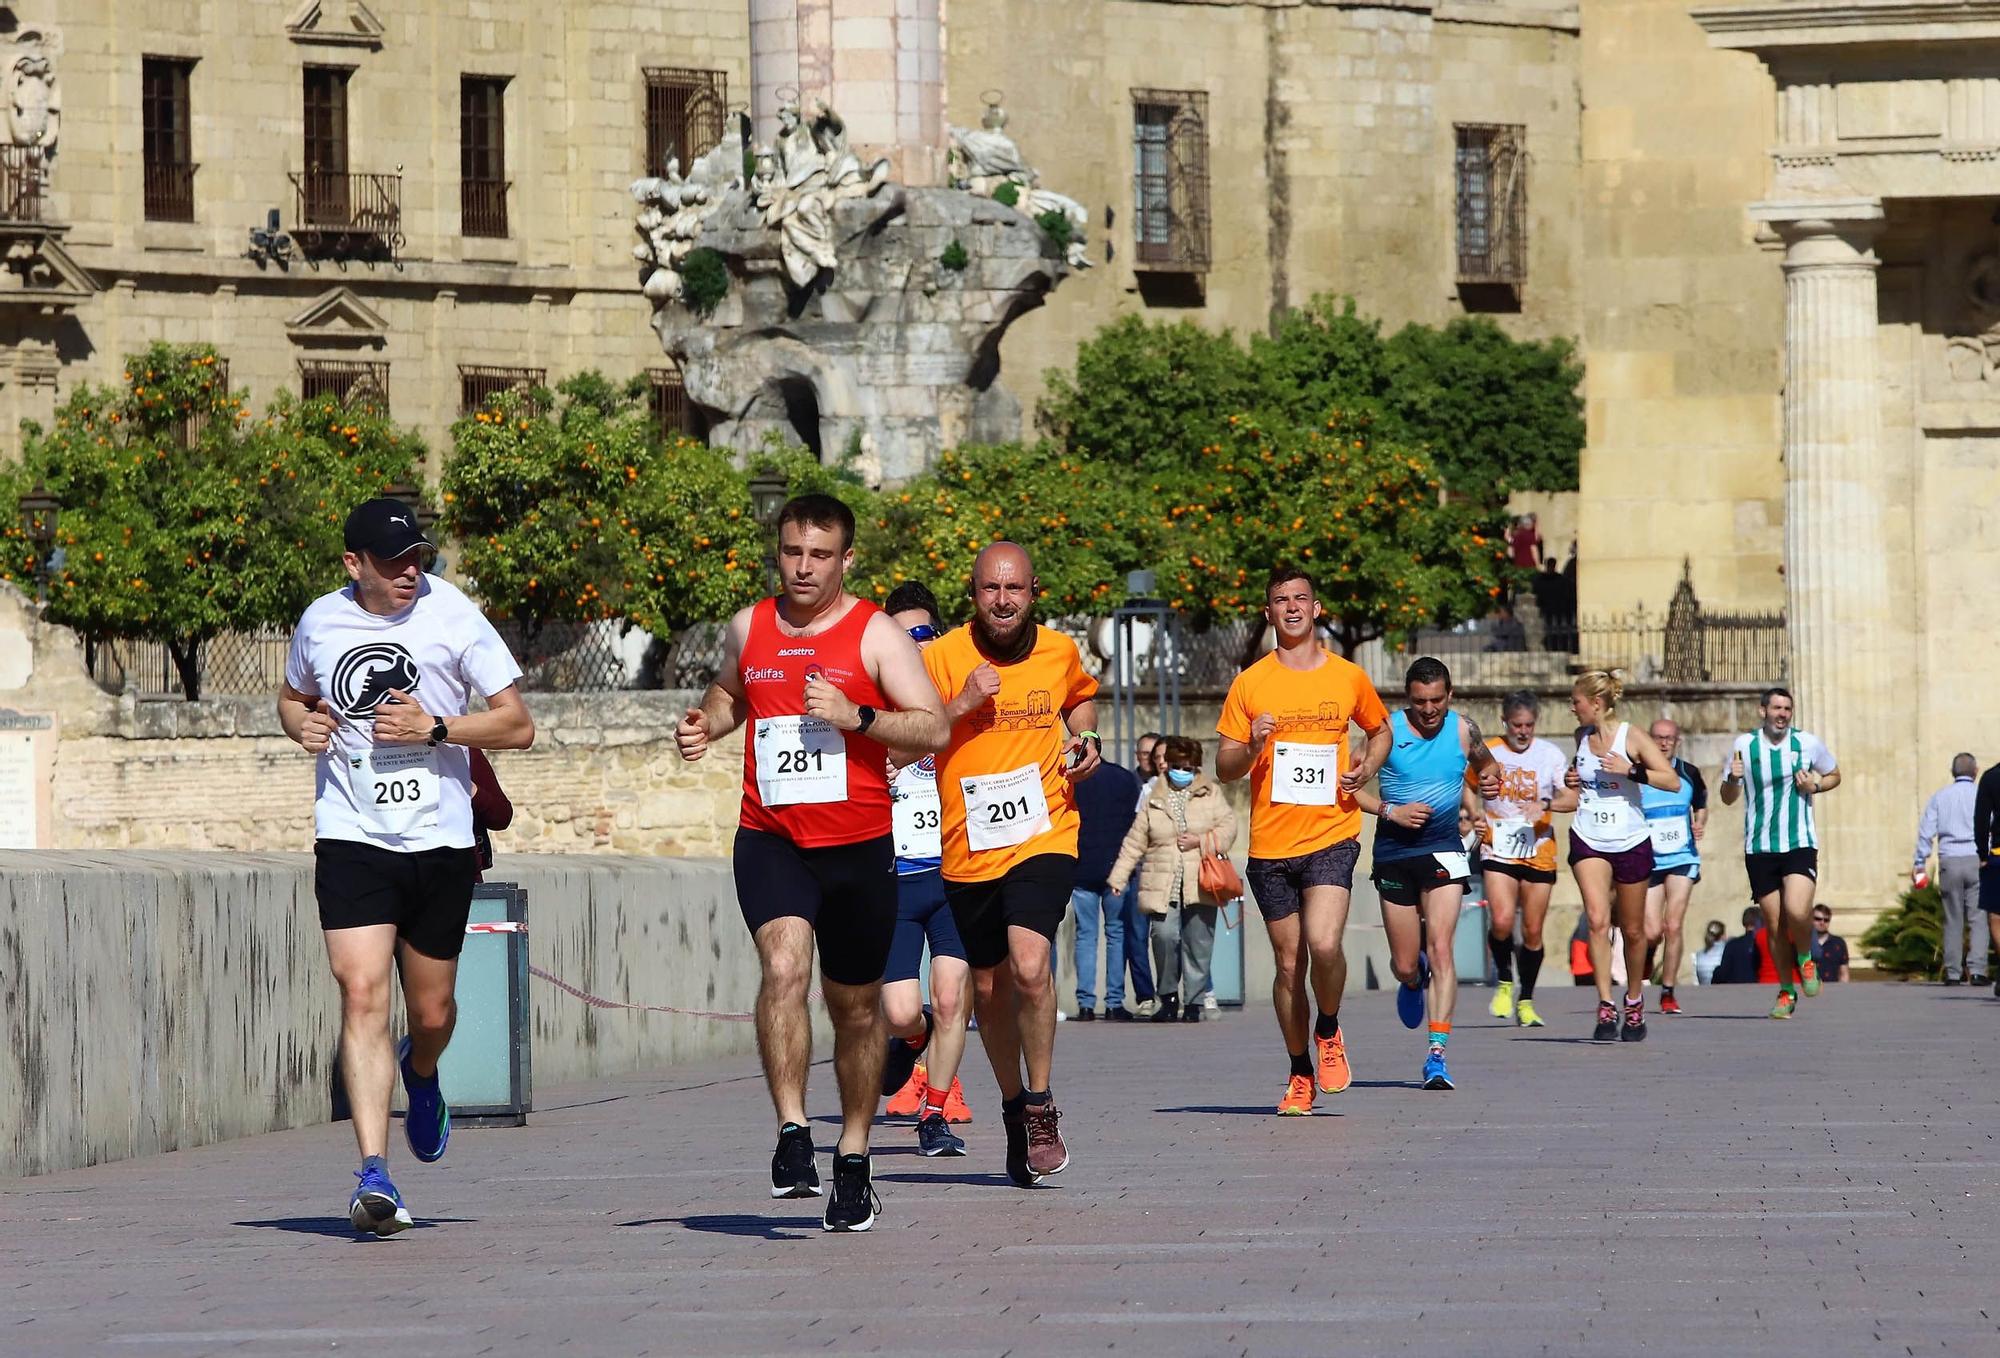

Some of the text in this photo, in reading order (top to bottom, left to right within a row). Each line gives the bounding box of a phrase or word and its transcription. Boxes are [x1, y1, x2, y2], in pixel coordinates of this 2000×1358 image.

[750, 668, 784, 680] califas
[777, 748, 822, 774] 281
[1293, 767, 1325, 784] 331
[374, 779, 421, 804] 203
[913, 809, 939, 829] 33
[987, 795, 1029, 823] 201
[1593, 812, 1617, 824] 191
